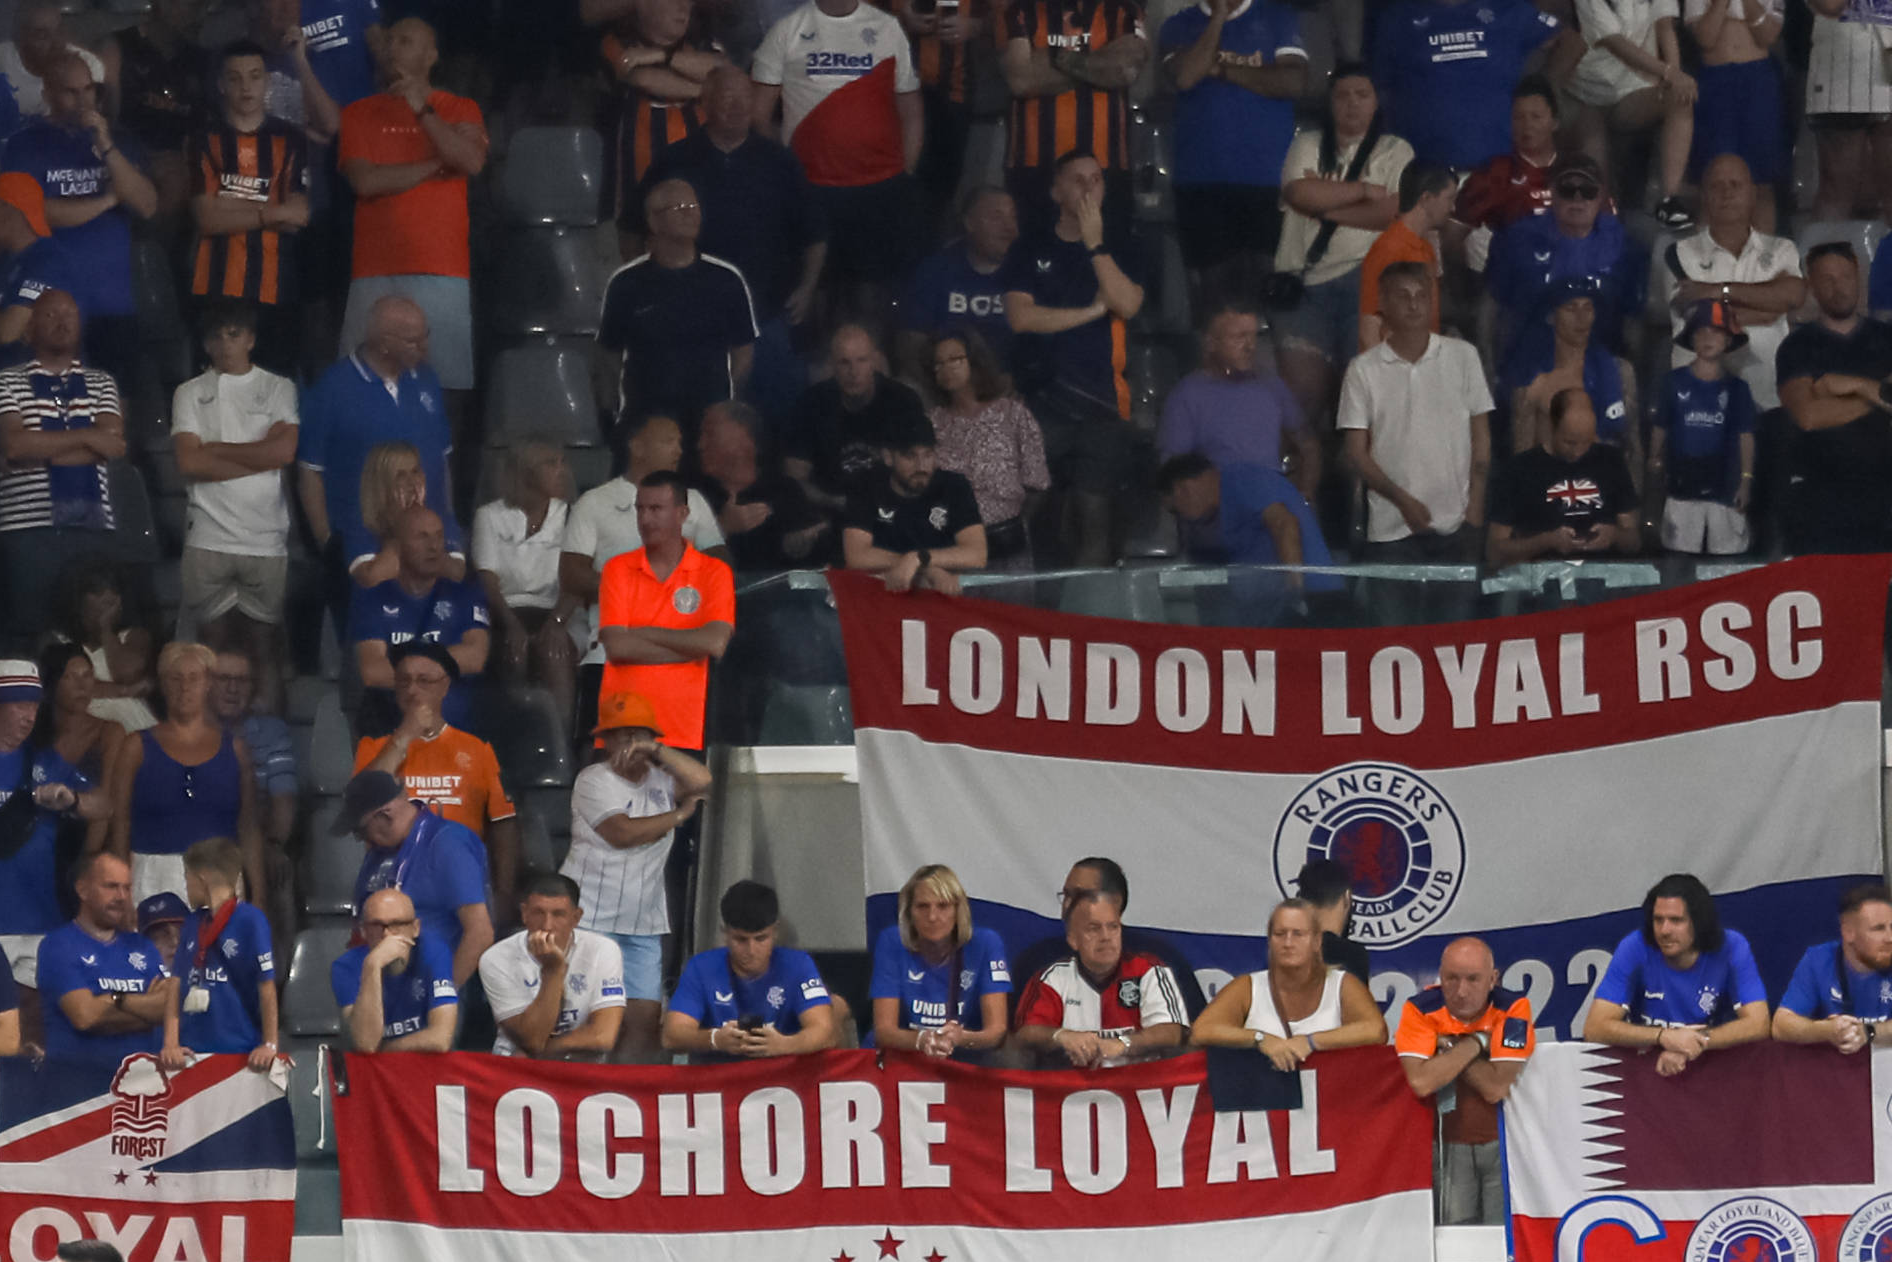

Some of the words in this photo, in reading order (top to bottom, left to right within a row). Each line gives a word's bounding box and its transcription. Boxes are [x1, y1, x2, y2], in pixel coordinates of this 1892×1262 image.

[301, 15, 344, 37] NIBET
[1428, 31, 1484, 45] UNIBET
[806, 52, 873, 68] 32Red
[899, 618, 1277, 737] LONDON
[1321, 632, 1599, 736] LOYAL
[1636, 590, 1824, 704] RSC
[405, 775, 463, 788] UNIBET
[1294, 772, 1442, 824] RANGERS
[1408, 869, 1453, 923] CLUB
[1351, 900, 1395, 915] EADY
[98, 977, 145, 992] UNIBET
[912, 999, 965, 1016] UNIBT
[435, 1081, 952, 1199] LOCHORE
[1004, 1069, 1337, 1195] LOYAL
[1718, 1204, 1762, 1222] LOYAL
[1763, 1208, 1790, 1228] AND
